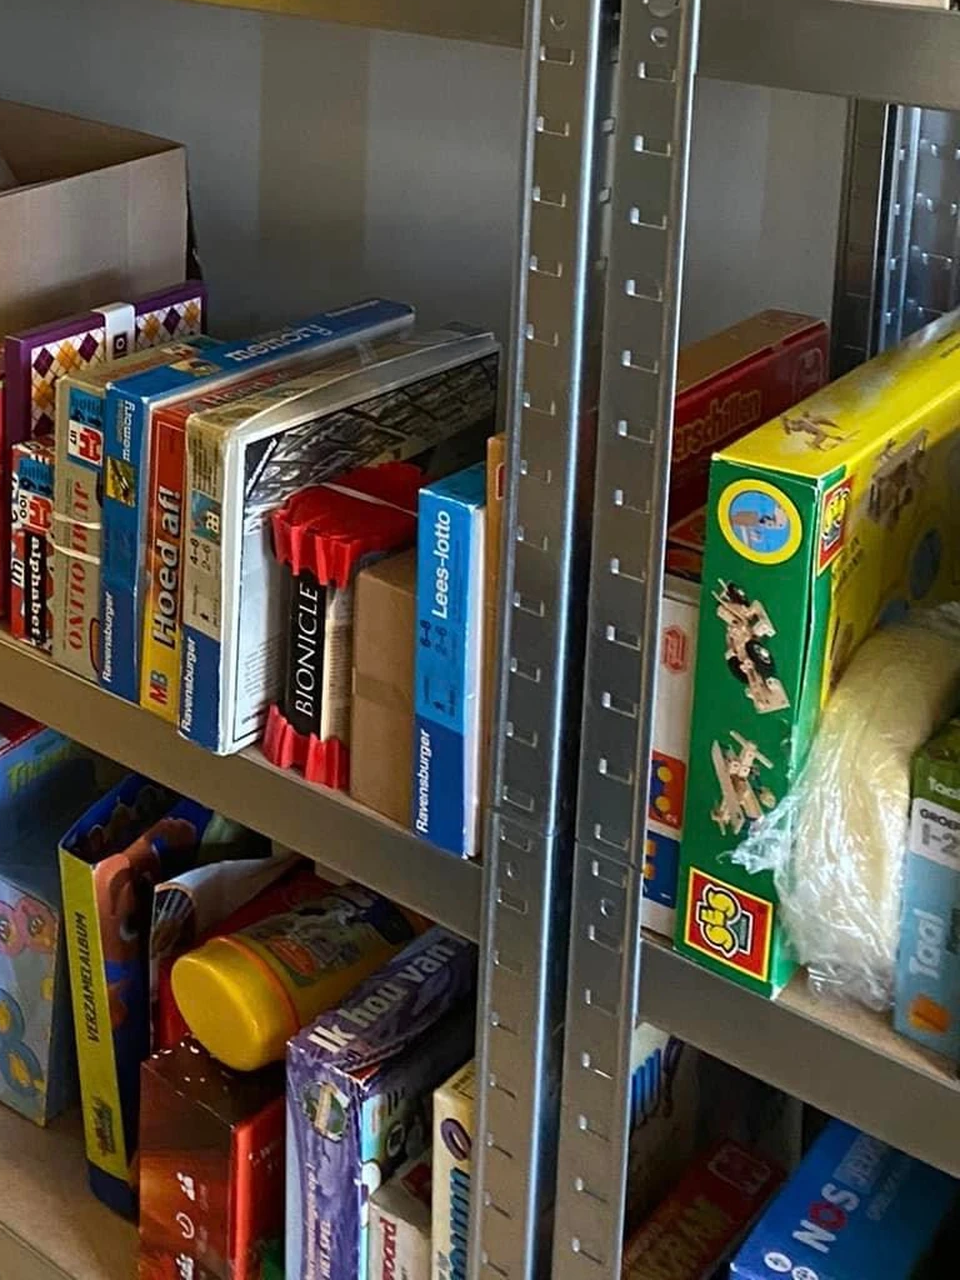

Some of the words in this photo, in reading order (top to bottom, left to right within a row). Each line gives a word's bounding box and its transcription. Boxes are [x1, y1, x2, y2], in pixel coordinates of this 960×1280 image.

[225, 322, 330, 362] memory
[124, 399, 137, 462] memory
[157, 486, 182, 534] af!
[28, 534, 43, 629] alphabet
[152, 537, 179, 650] Hoed
[431, 509, 452, 621] Lees-lotto
[100, 590, 115, 683] Ravensburger
[295, 581, 319, 719] BIONICLE
[149, 670, 170, 708] MB
[180, 635, 197, 734] Ravensburger
[415, 727, 431, 834] Ravensburger
[72, 911, 100, 1044] VERZAMELALBUM
[908, 918, 943, 980] Taal
[308, 1020, 358, 1054] Ik
[338, 985, 404, 1032] hou
[402, 940, 456, 992] van
[792, 1181, 860, 1255] NOS
